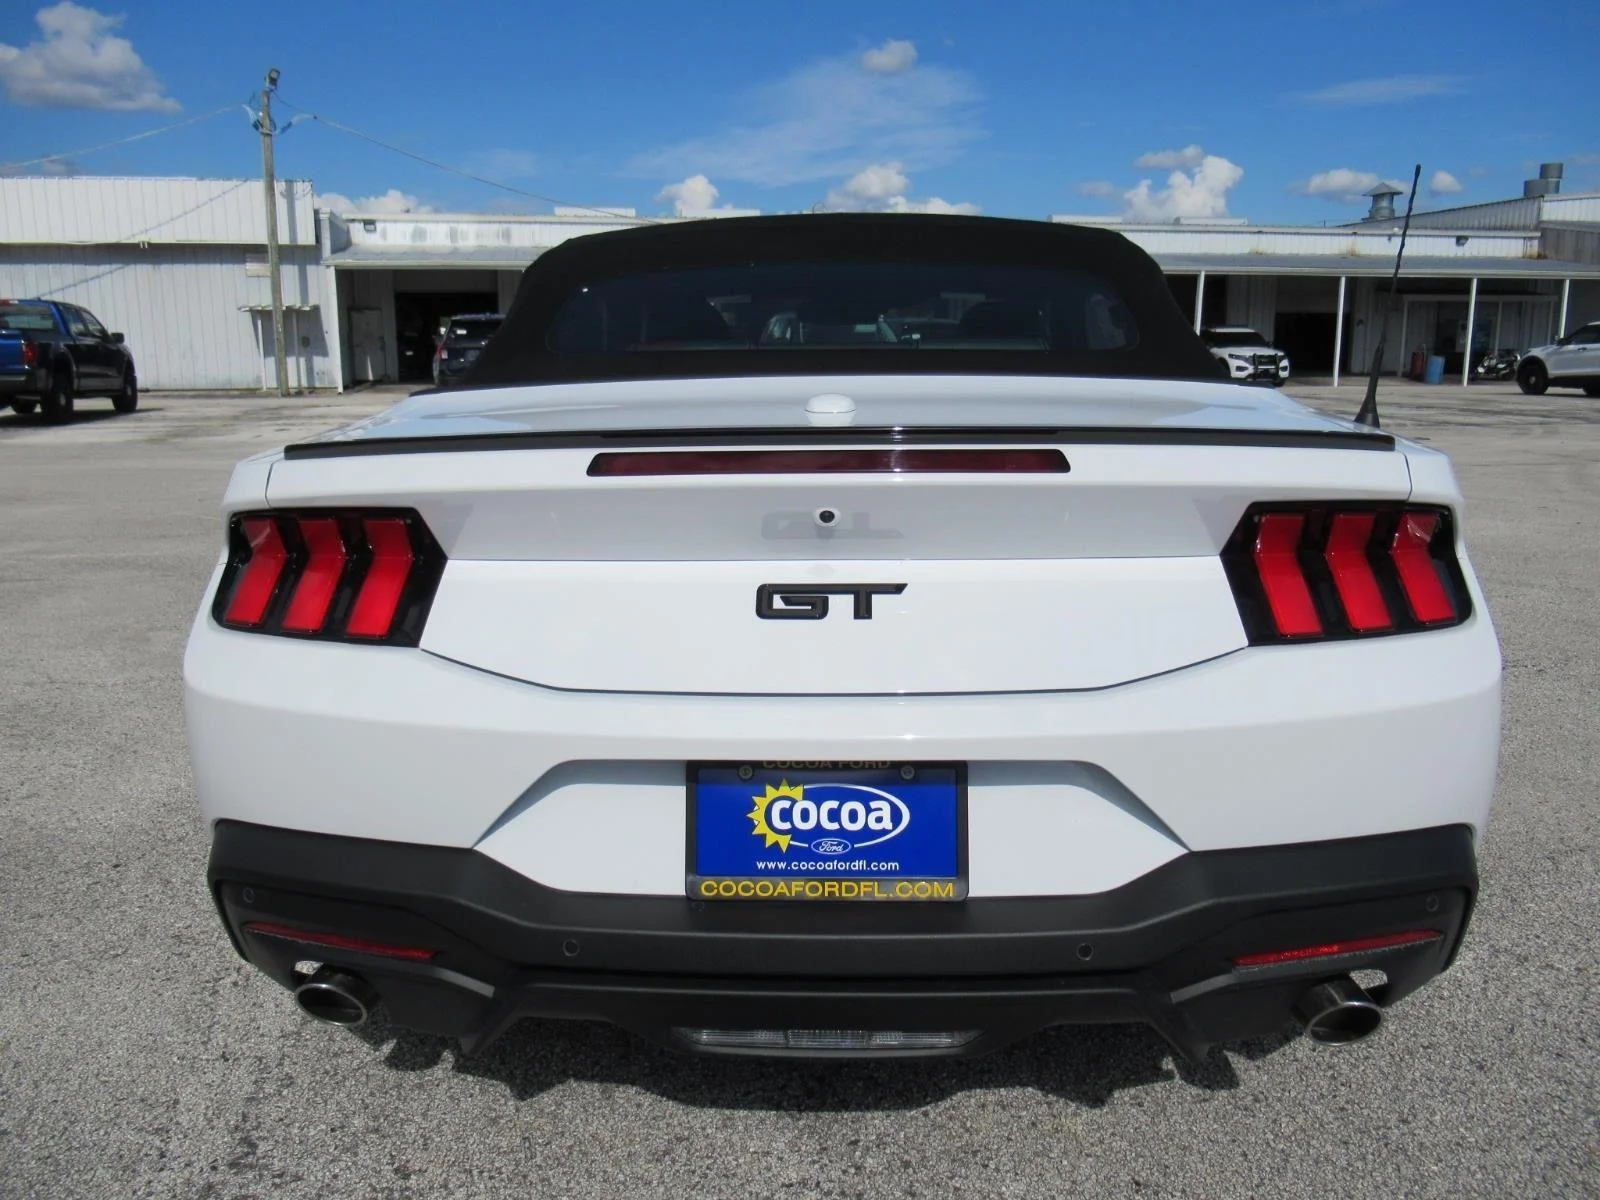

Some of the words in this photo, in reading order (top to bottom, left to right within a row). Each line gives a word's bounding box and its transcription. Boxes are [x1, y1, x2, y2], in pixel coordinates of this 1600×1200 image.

[756, 583, 908, 620] GT
[819, 841, 843, 852] Ford
[756, 859, 899, 871] www.cocoafordfl.com
[701, 881, 954, 897] COCOAFORDFL.COM
